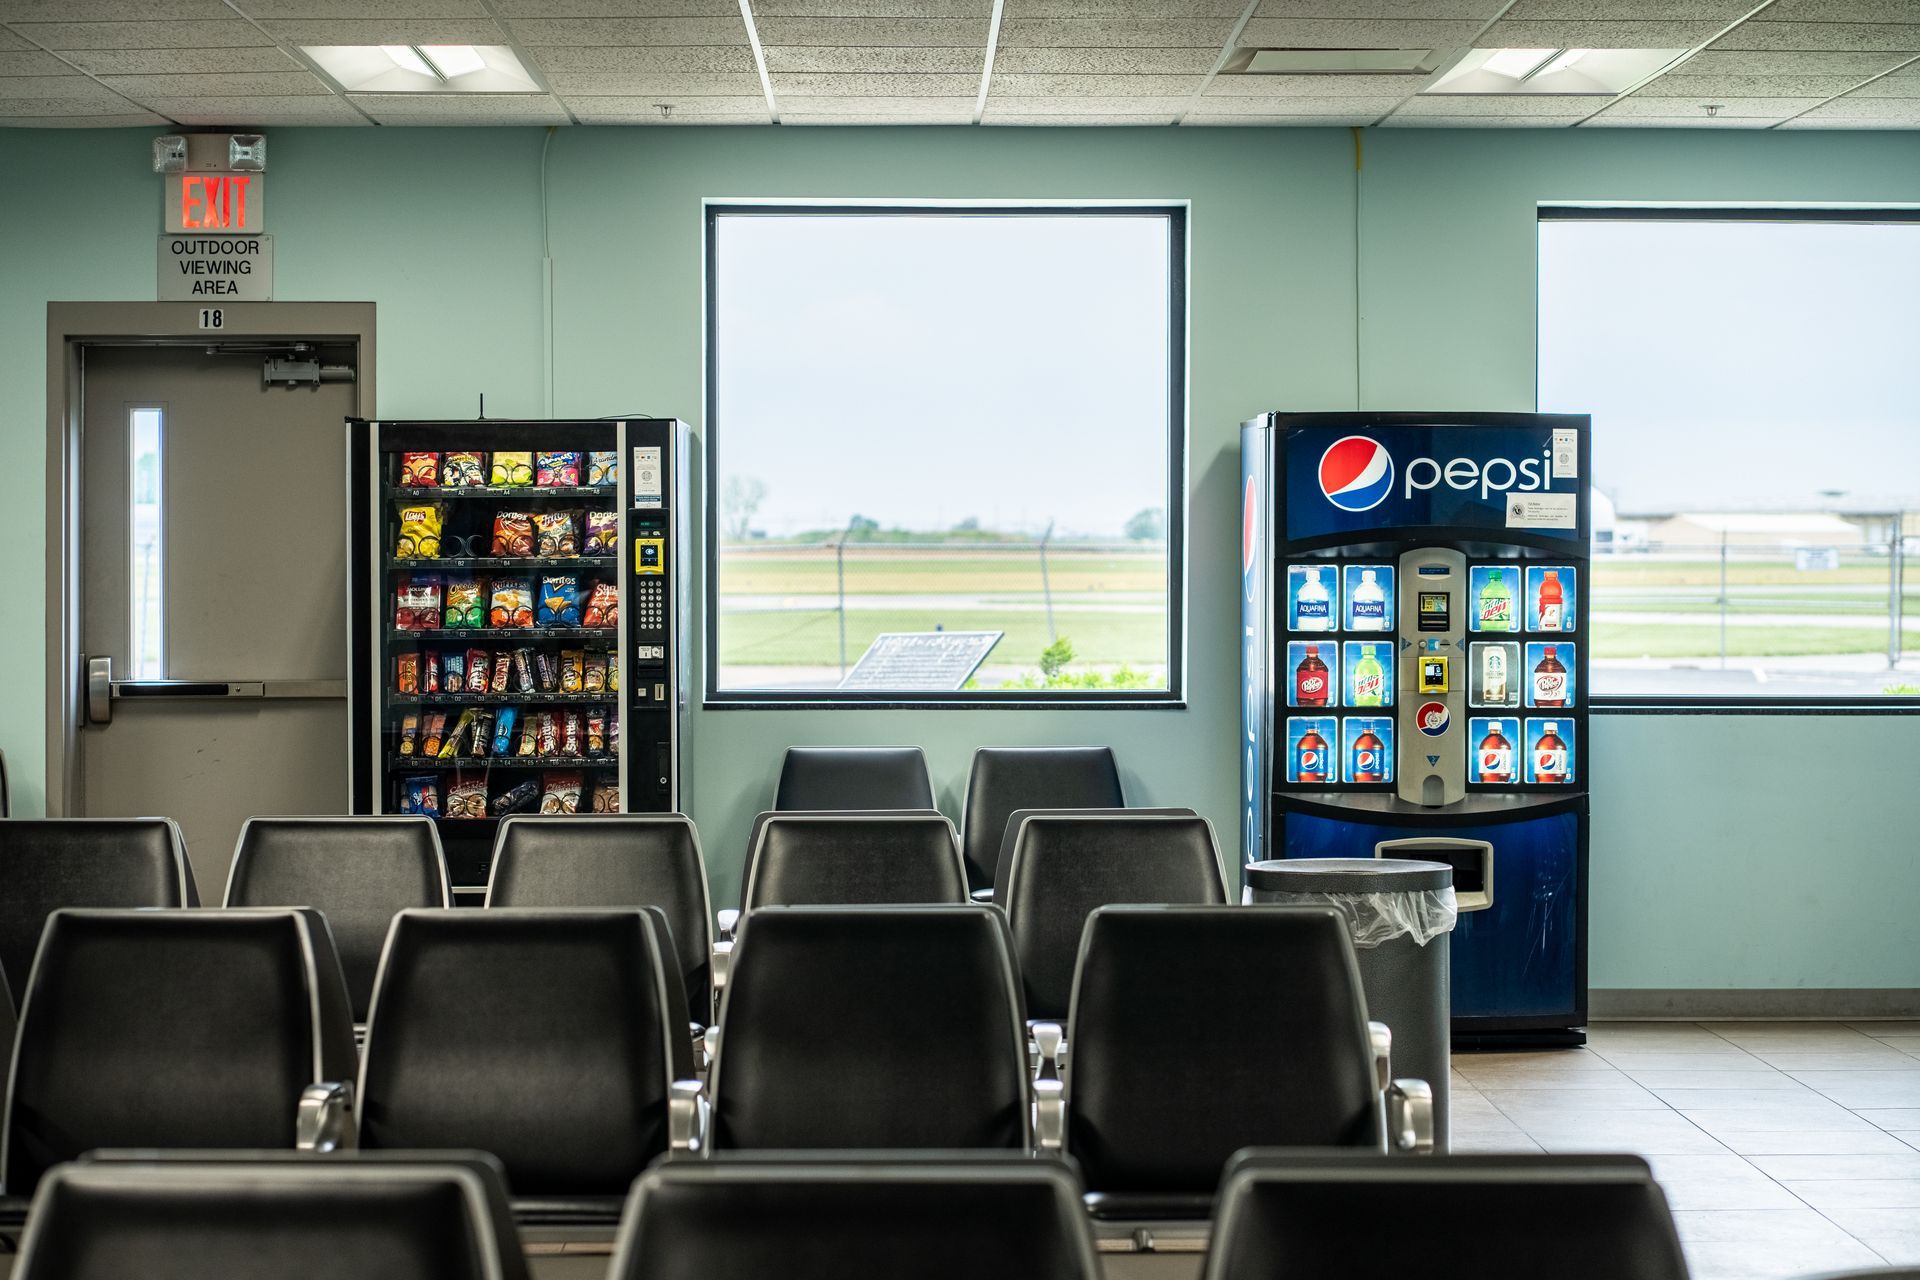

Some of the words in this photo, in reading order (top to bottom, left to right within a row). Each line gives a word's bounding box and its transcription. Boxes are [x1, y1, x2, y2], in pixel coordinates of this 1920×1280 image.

[182, 175, 250, 229] EXIT
[171, 240, 260, 255] OUTDOOR
[179, 260, 252, 275] VIEWING
[191, 280, 239, 295] AREA
[202, 310, 223, 328] 18
[1405, 449, 1551, 500] pepsi
[542, 575, 576, 585] Doritos
[1299, 604, 1327, 613] AQUAFINA
[1355, 604, 1383, 613] AQUAFINA
[543, 714, 554, 751] Skittles
[566, 714, 577, 752] Skittles
